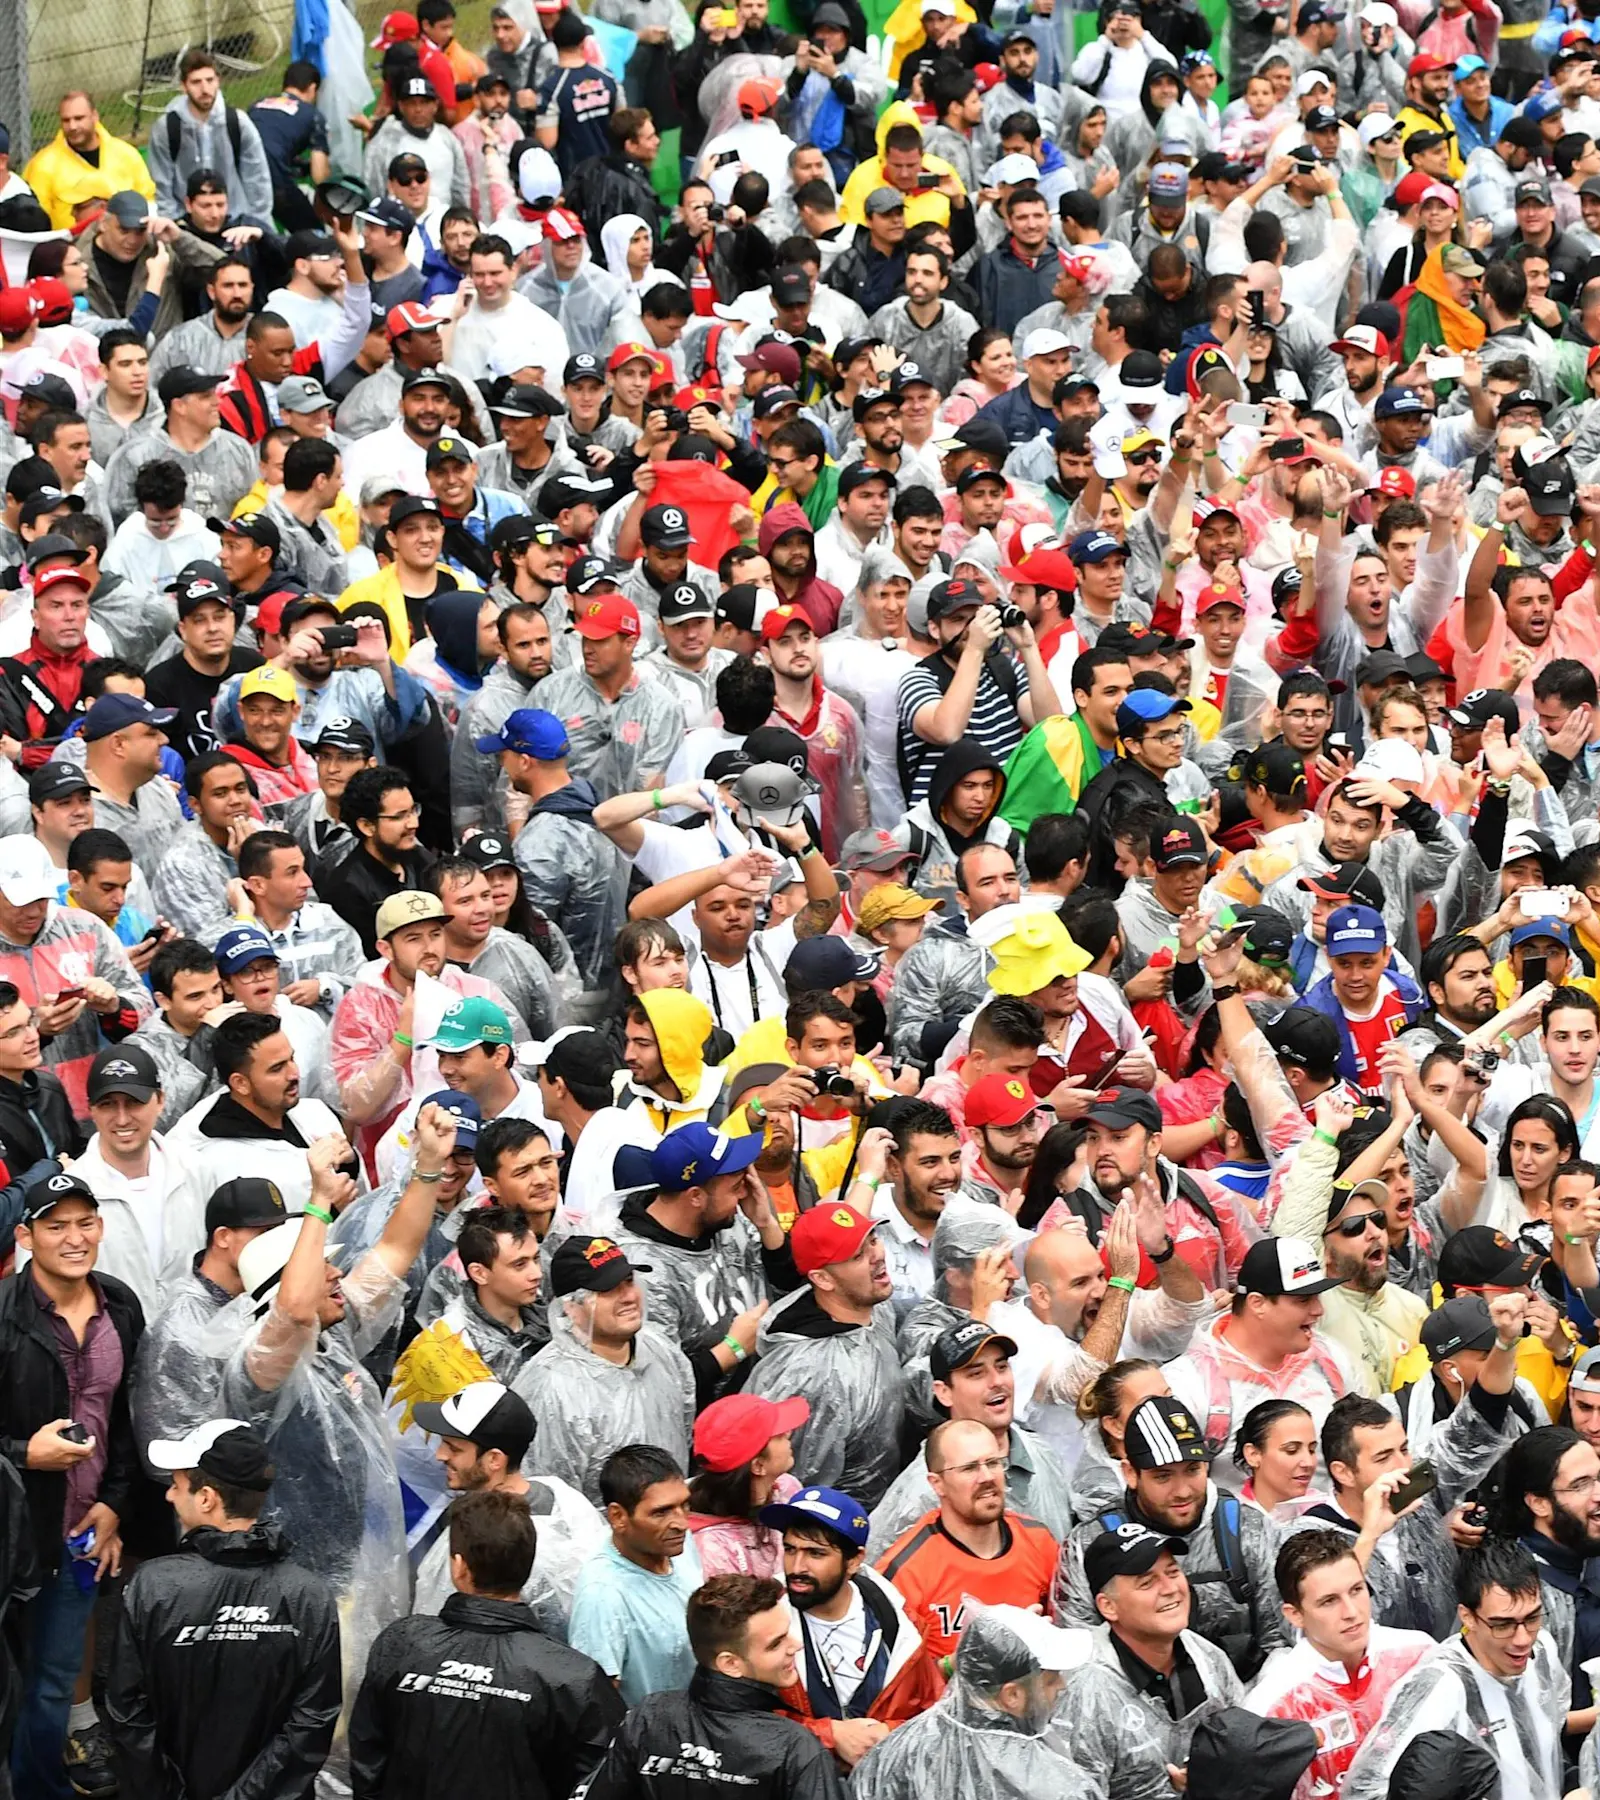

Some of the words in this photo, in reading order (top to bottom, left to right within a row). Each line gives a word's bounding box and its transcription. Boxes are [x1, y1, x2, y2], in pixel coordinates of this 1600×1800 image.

[258, 667, 275, 680] 12
[216, 1605, 270, 1623] 2016
[936, 1606, 966, 1637] 14
[437, 1660, 494, 1684] 2016
[427, 1685, 441, 1694] DO
[434, 1677, 469, 1691] FORMULA
[474, 1684, 505, 1697] GRANDE
[679, 1742, 723, 1768] 2016
